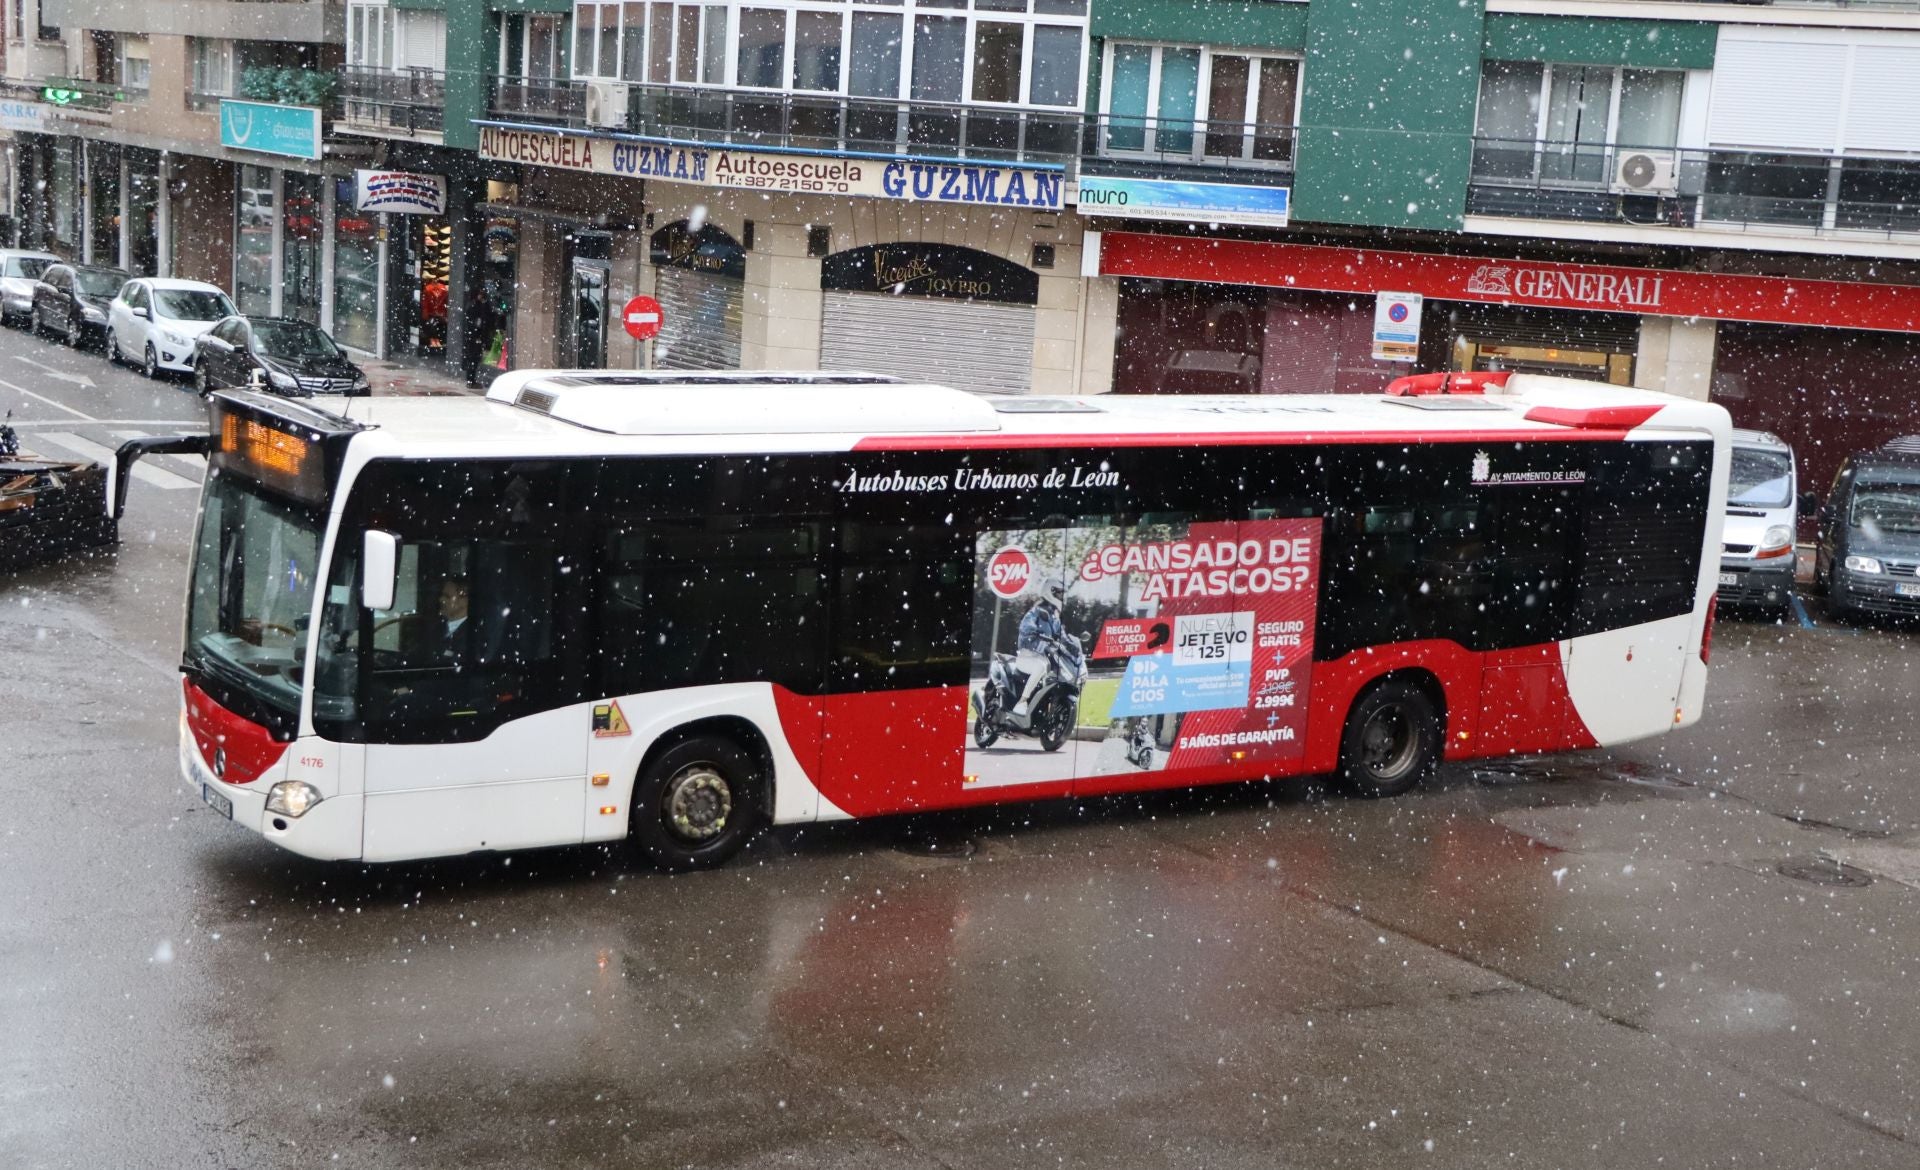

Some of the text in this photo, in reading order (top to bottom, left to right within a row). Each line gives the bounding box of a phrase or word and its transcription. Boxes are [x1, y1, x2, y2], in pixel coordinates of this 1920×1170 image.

[481, 128, 709, 181] AUTOESCUELA GUZMAN
[715, 153, 862, 182] Autoescuela
[715, 174, 742, 186] Tlf.:
[745, 176, 776, 188] 987
[883, 162, 1064, 207] GUZMAN
[1080, 188, 1128, 206] muro
[927, 277, 991, 296] JOYERO
[1514, 269, 1664, 306] GENERALI
[839, 470, 949, 492] Autobuses
[954, 468, 1039, 490] Urbanos
[1042, 468, 1066, 488] de
[1553, 471, 1564, 480] DE
[1565, 468, 1586, 480] LEÓN
[1082, 538, 1311, 581] ¿CANSADO DE
[990, 562, 1029, 586] SYM
[1144, 567, 1310, 600] ATASCOS?
[1901, 584, 1920, 594] 795
[1105, 624, 1141, 635] REGALO
[1180, 617, 1236, 633] NUEVA
[1257, 620, 1304, 635] SEGURO
[1105, 633, 1146, 645] UN CASCO
[1179, 630, 1247, 647] JET EVO
[1259, 633, 1301, 647] GRATIS
[1124, 643, 1140, 653] JET
[1198, 645, 1225, 659] 125
[1132, 674, 1169, 689] PALA
[1265, 668, 1290, 681] PVP
[1131, 688, 1165, 703] CIOS
[1254, 693, 1295, 709] 2.999€
[1179, 725, 1295, 749] 5 AÑOS DE GARANTÍA
[300, 757, 324, 769] 4176
